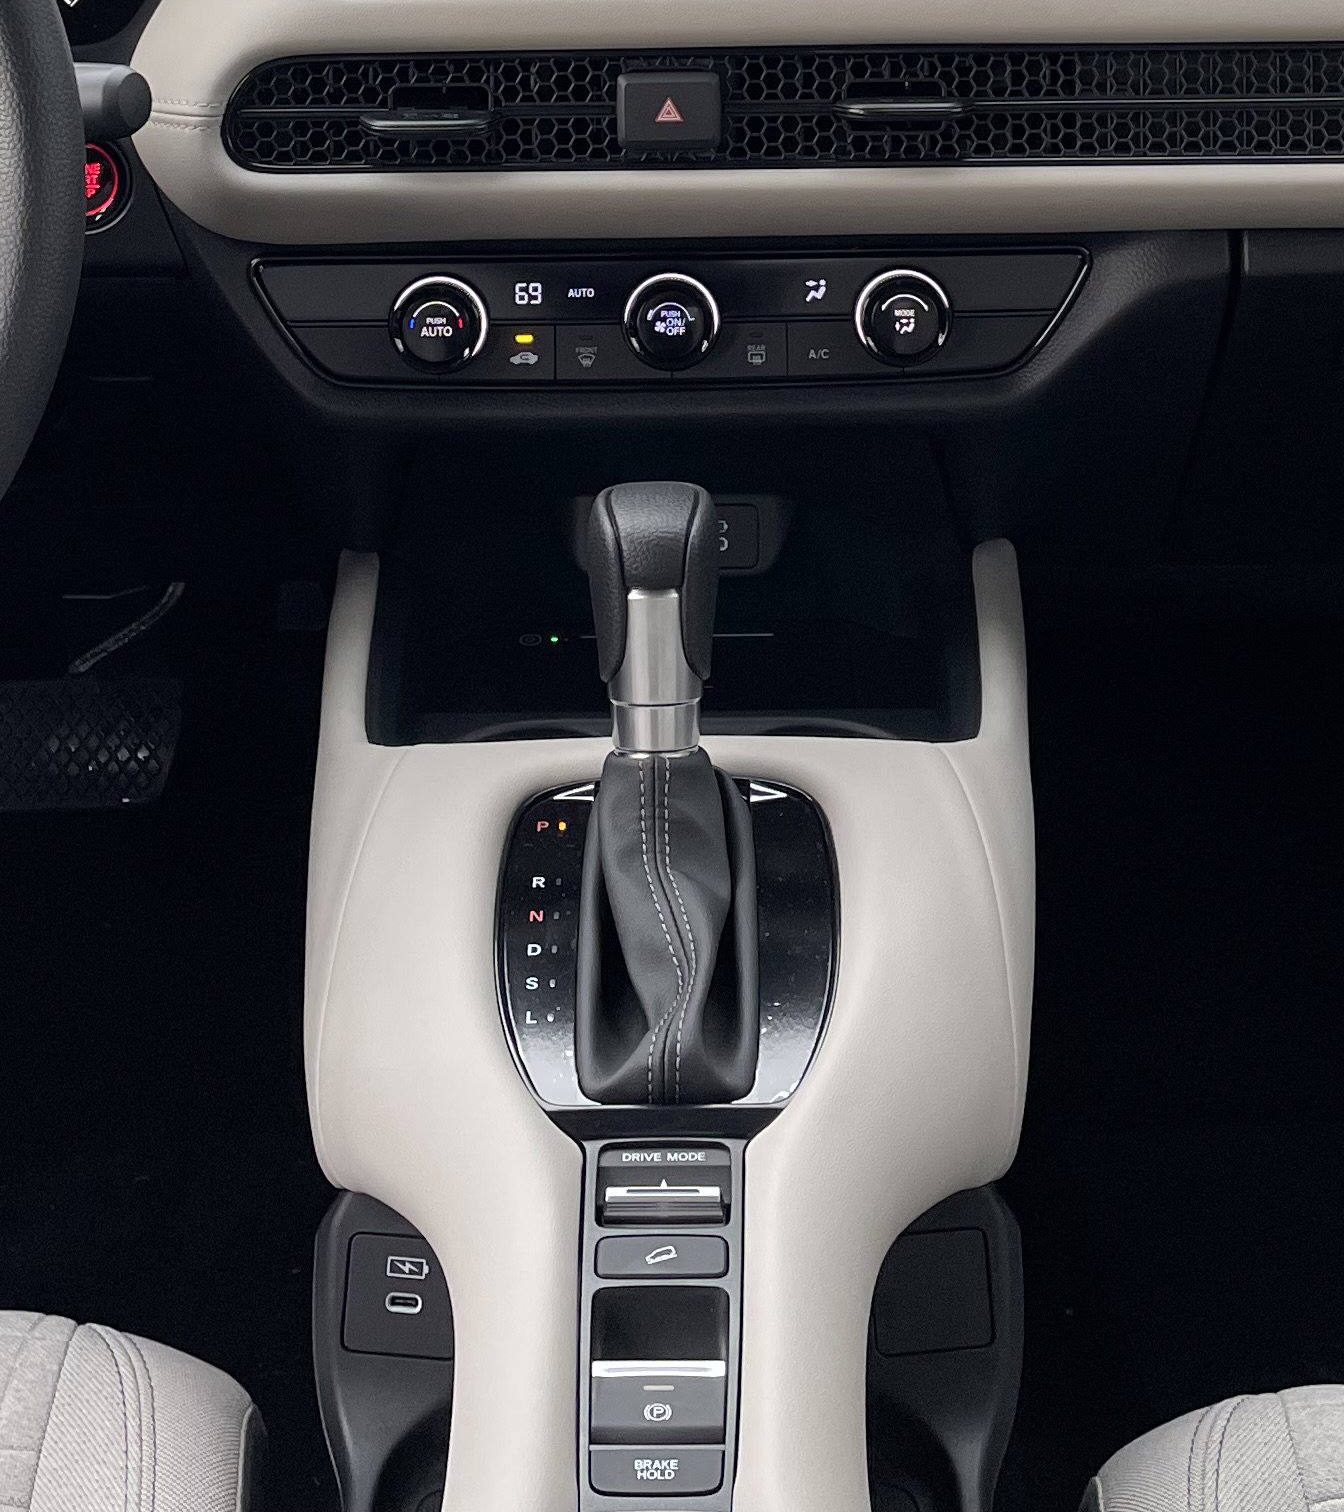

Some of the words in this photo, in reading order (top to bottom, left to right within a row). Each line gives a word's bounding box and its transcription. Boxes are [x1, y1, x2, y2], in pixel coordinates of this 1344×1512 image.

[515, 283, 542, 305] 69
[568, 288, 595, 298] AUTO
[661, 310, 681, 318] PUSH
[894, 309, 915, 317] MODE
[426, 317, 446, 325] PUSH
[666, 318, 686, 326] ON/
[420, 326, 453, 337] AUTO
[666, 327, 686, 336] OFF
[809, 349, 830, 359] A/C
[537, 821, 549, 832] P
[532, 876, 546, 889] R
[529, 910, 544, 922] N
[527, 944, 542, 956] D
[526, 977, 539, 990] S
[526, 1012, 537, 1024] L
[622, 1152, 662, 1162] DRIVE
[667, 1151, 706, 1162] MODE
[634, 1460, 679, 1470] BRAKE
[637, 1469, 674, 1480] HOLD
